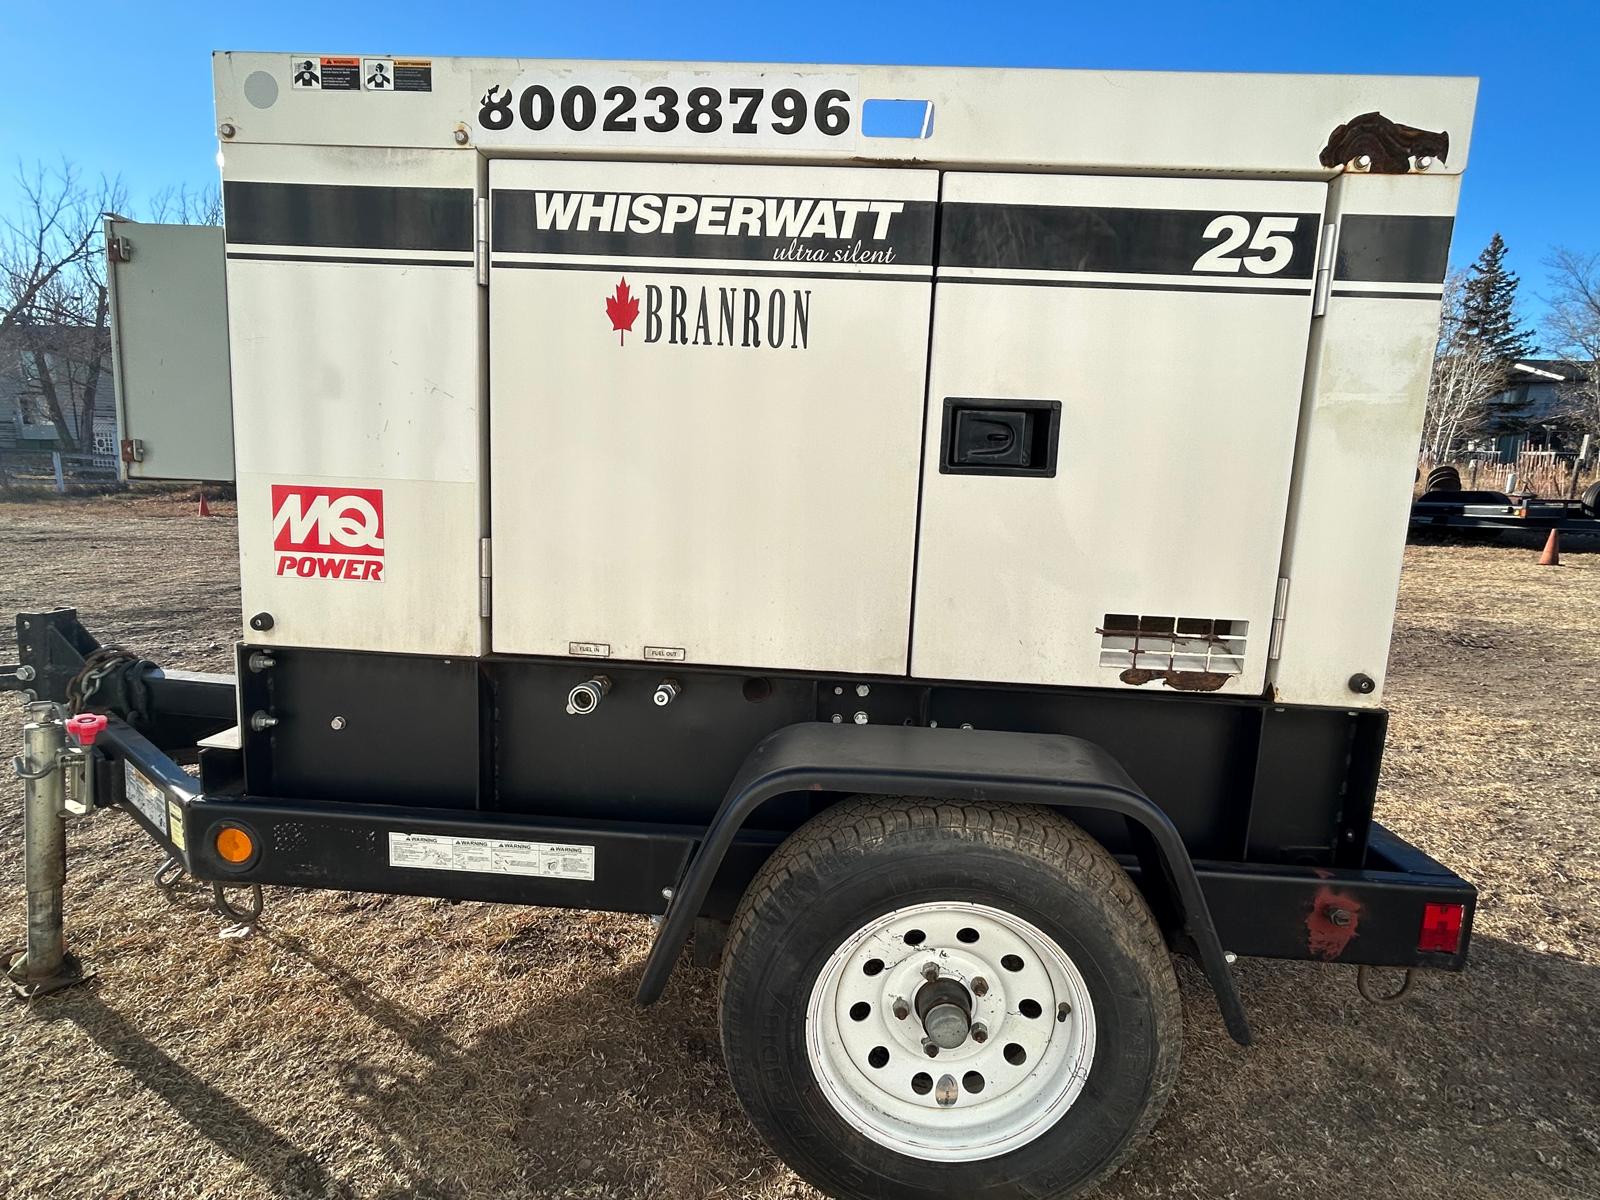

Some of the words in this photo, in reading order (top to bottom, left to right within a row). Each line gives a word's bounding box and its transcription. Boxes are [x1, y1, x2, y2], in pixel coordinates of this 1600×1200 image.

[478, 84, 851, 136] 800238796
[535, 192, 904, 240] WHISPERWATT
[772, 238, 829, 261] ultra
[832, 239, 896, 264] silent
[1192, 214, 1299, 275] 25
[644, 284, 812, 350] BRANRON
[273, 493, 384, 550] MQ
[276, 556, 384, 581] POWER
